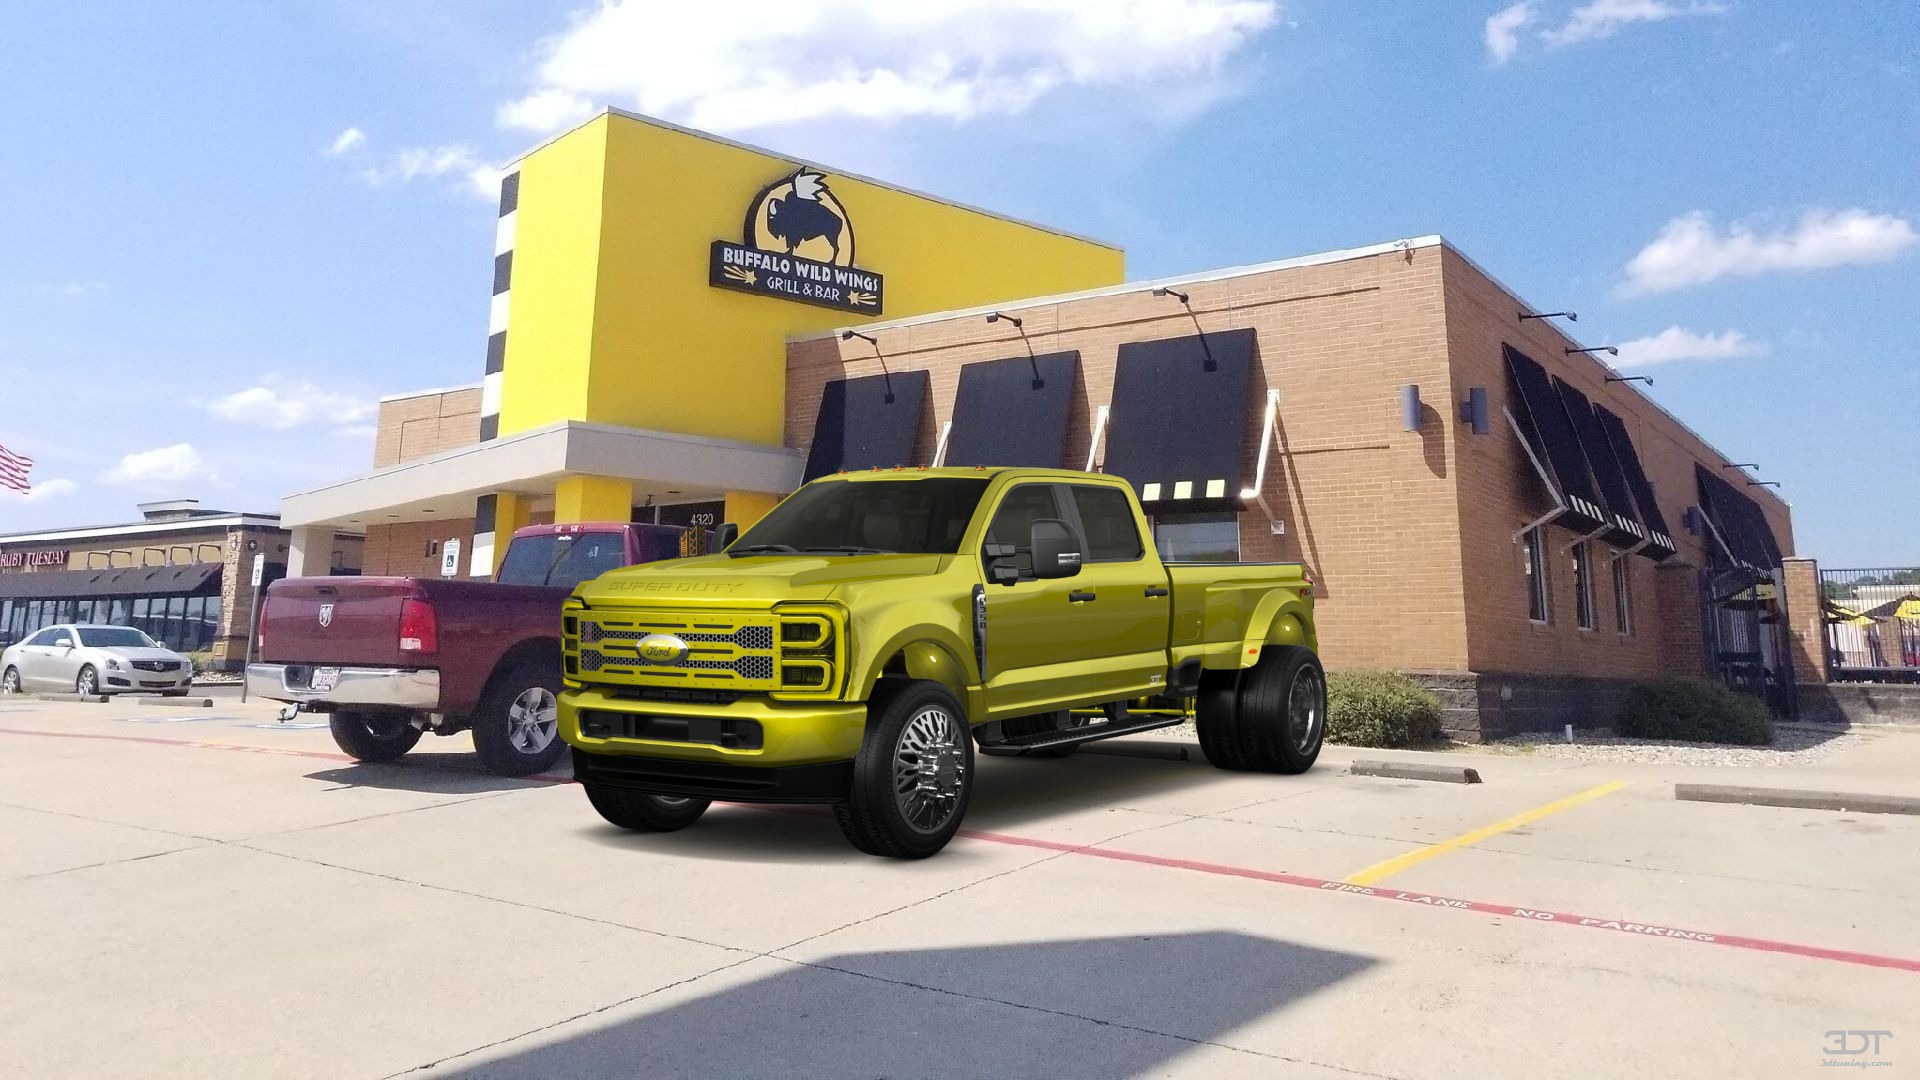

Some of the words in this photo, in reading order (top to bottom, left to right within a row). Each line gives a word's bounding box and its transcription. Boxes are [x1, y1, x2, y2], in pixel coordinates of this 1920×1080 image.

[723, 247, 790, 274] BUFFALO
[795, 261, 831, 282] WILD
[834, 269, 878, 292] WINGS
[766, 276, 799, 295] GRILL
[802, 282, 812, 297] &
[814, 286, 840, 302] BAR
[691, 513, 714, 526] 4320
[0, 553, 22, 567] RUBY
[26, 550, 66, 566] TUESDAY
[676, 583, 743, 593] DUTY
[646, 646, 672, 657] Ford
[1320, 882, 1375, 896] FIRE
[1395, 892, 1472, 910] LANE
[1513, 908, 1555, 921] NO
[1579, 918, 1716, 943] PARKING
